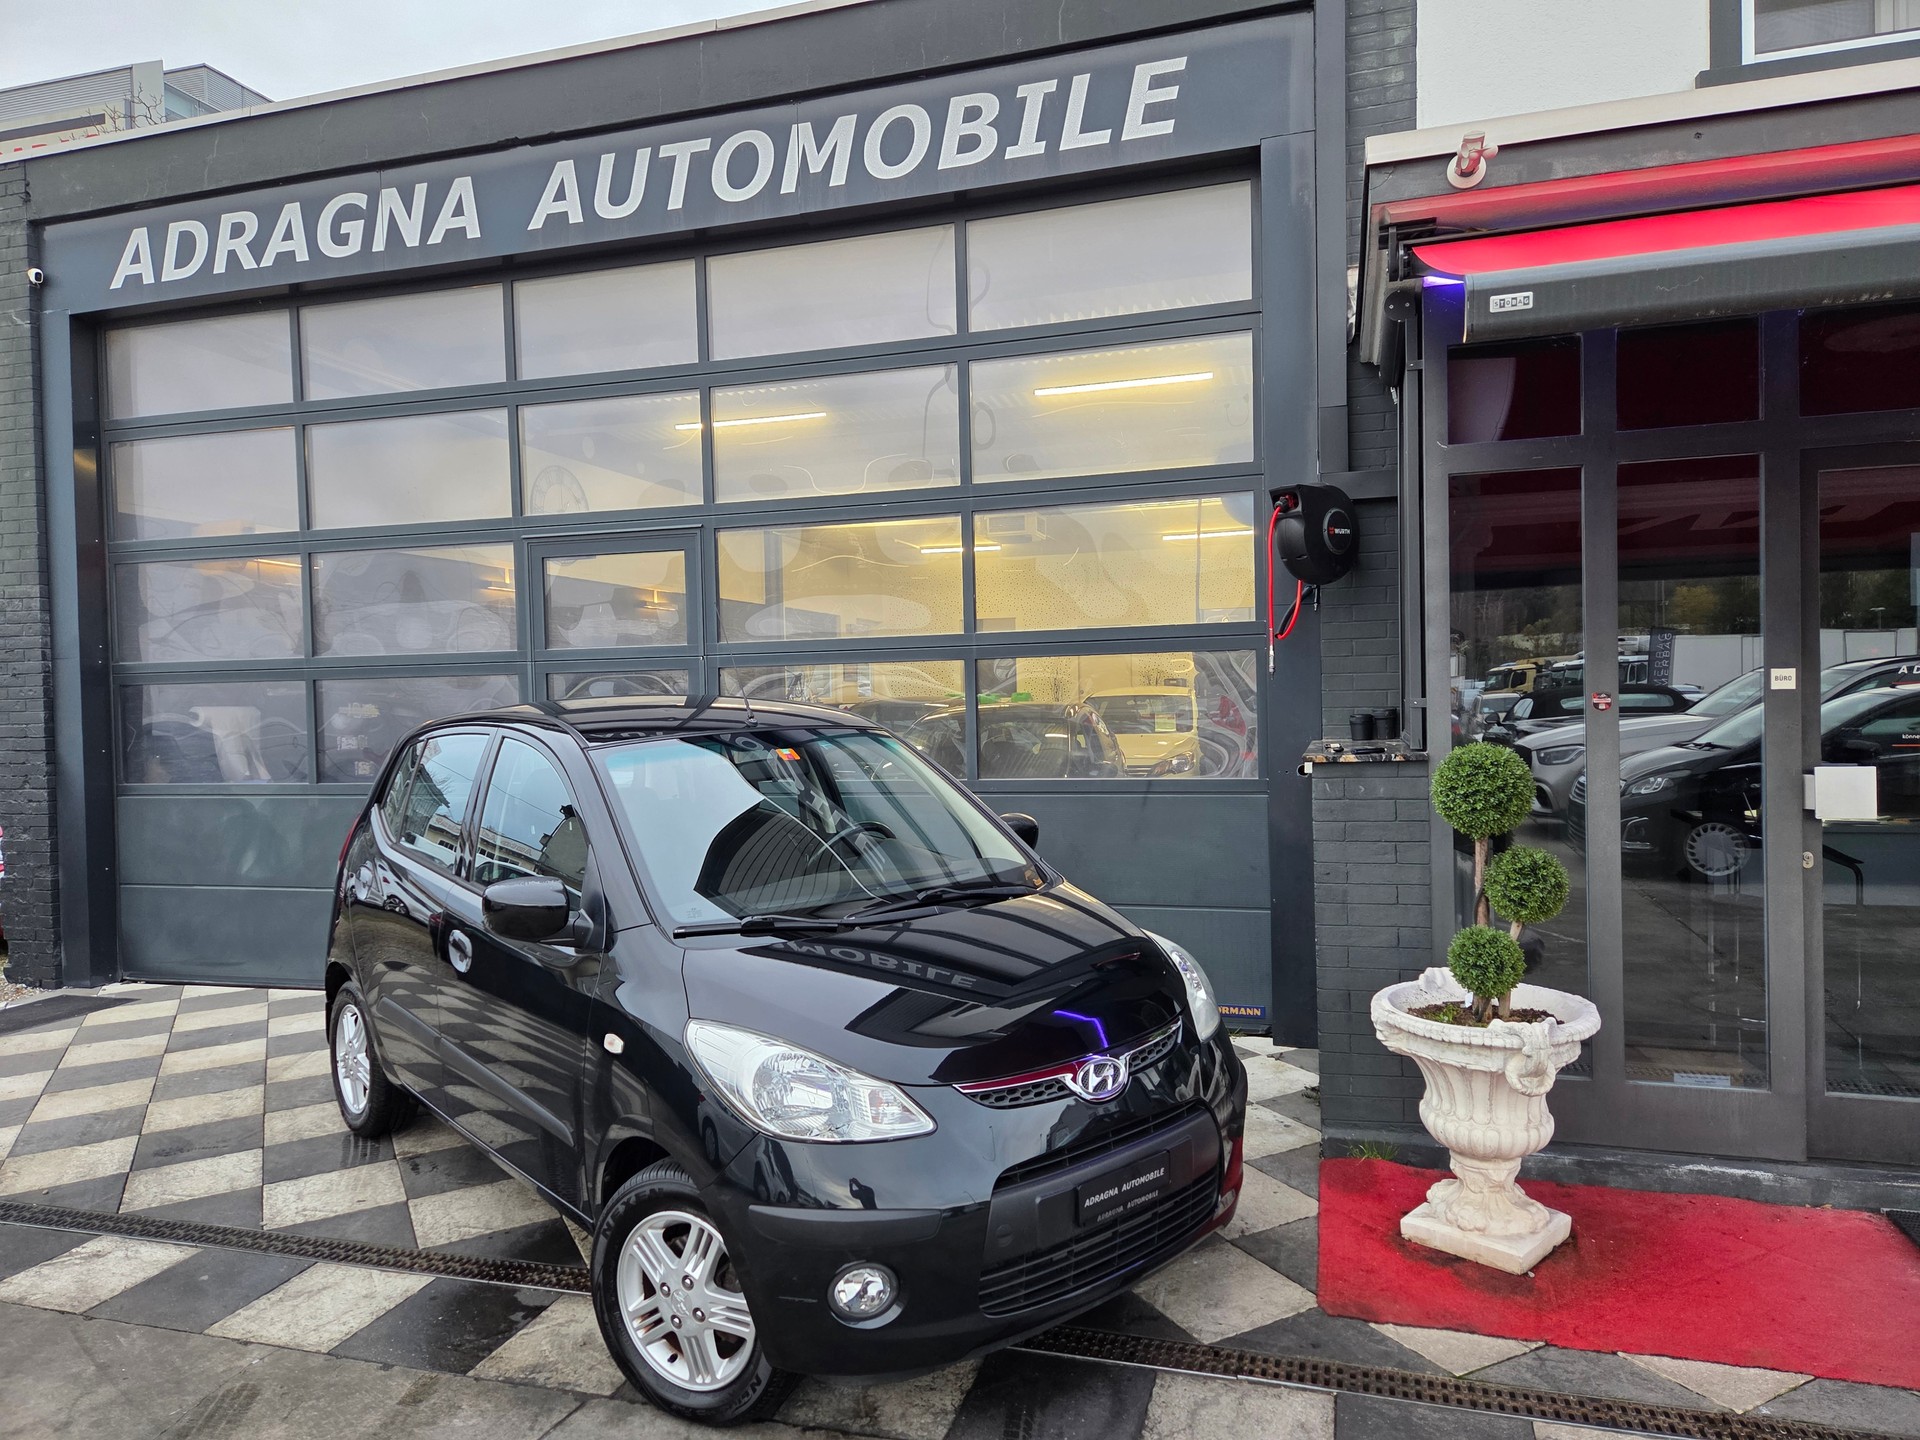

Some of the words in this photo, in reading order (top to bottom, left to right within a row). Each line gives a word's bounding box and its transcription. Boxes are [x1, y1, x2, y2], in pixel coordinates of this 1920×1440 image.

[110, 176, 481, 290] ADRAGNA
[527, 56, 1188, 231] AUTOMOBILE
[1493, 296, 1530, 308] STOBAG
[1774, 674, 1793, 682] BÜRO
[1084, 1187, 1119, 1208] ADRAGNA
[1122, 1167, 1165, 1191] AUTOMOBILE
[1127, 1190, 1159, 1209] AUTOMOBILE
[601, 1188, 664, 1240] NEXEN
